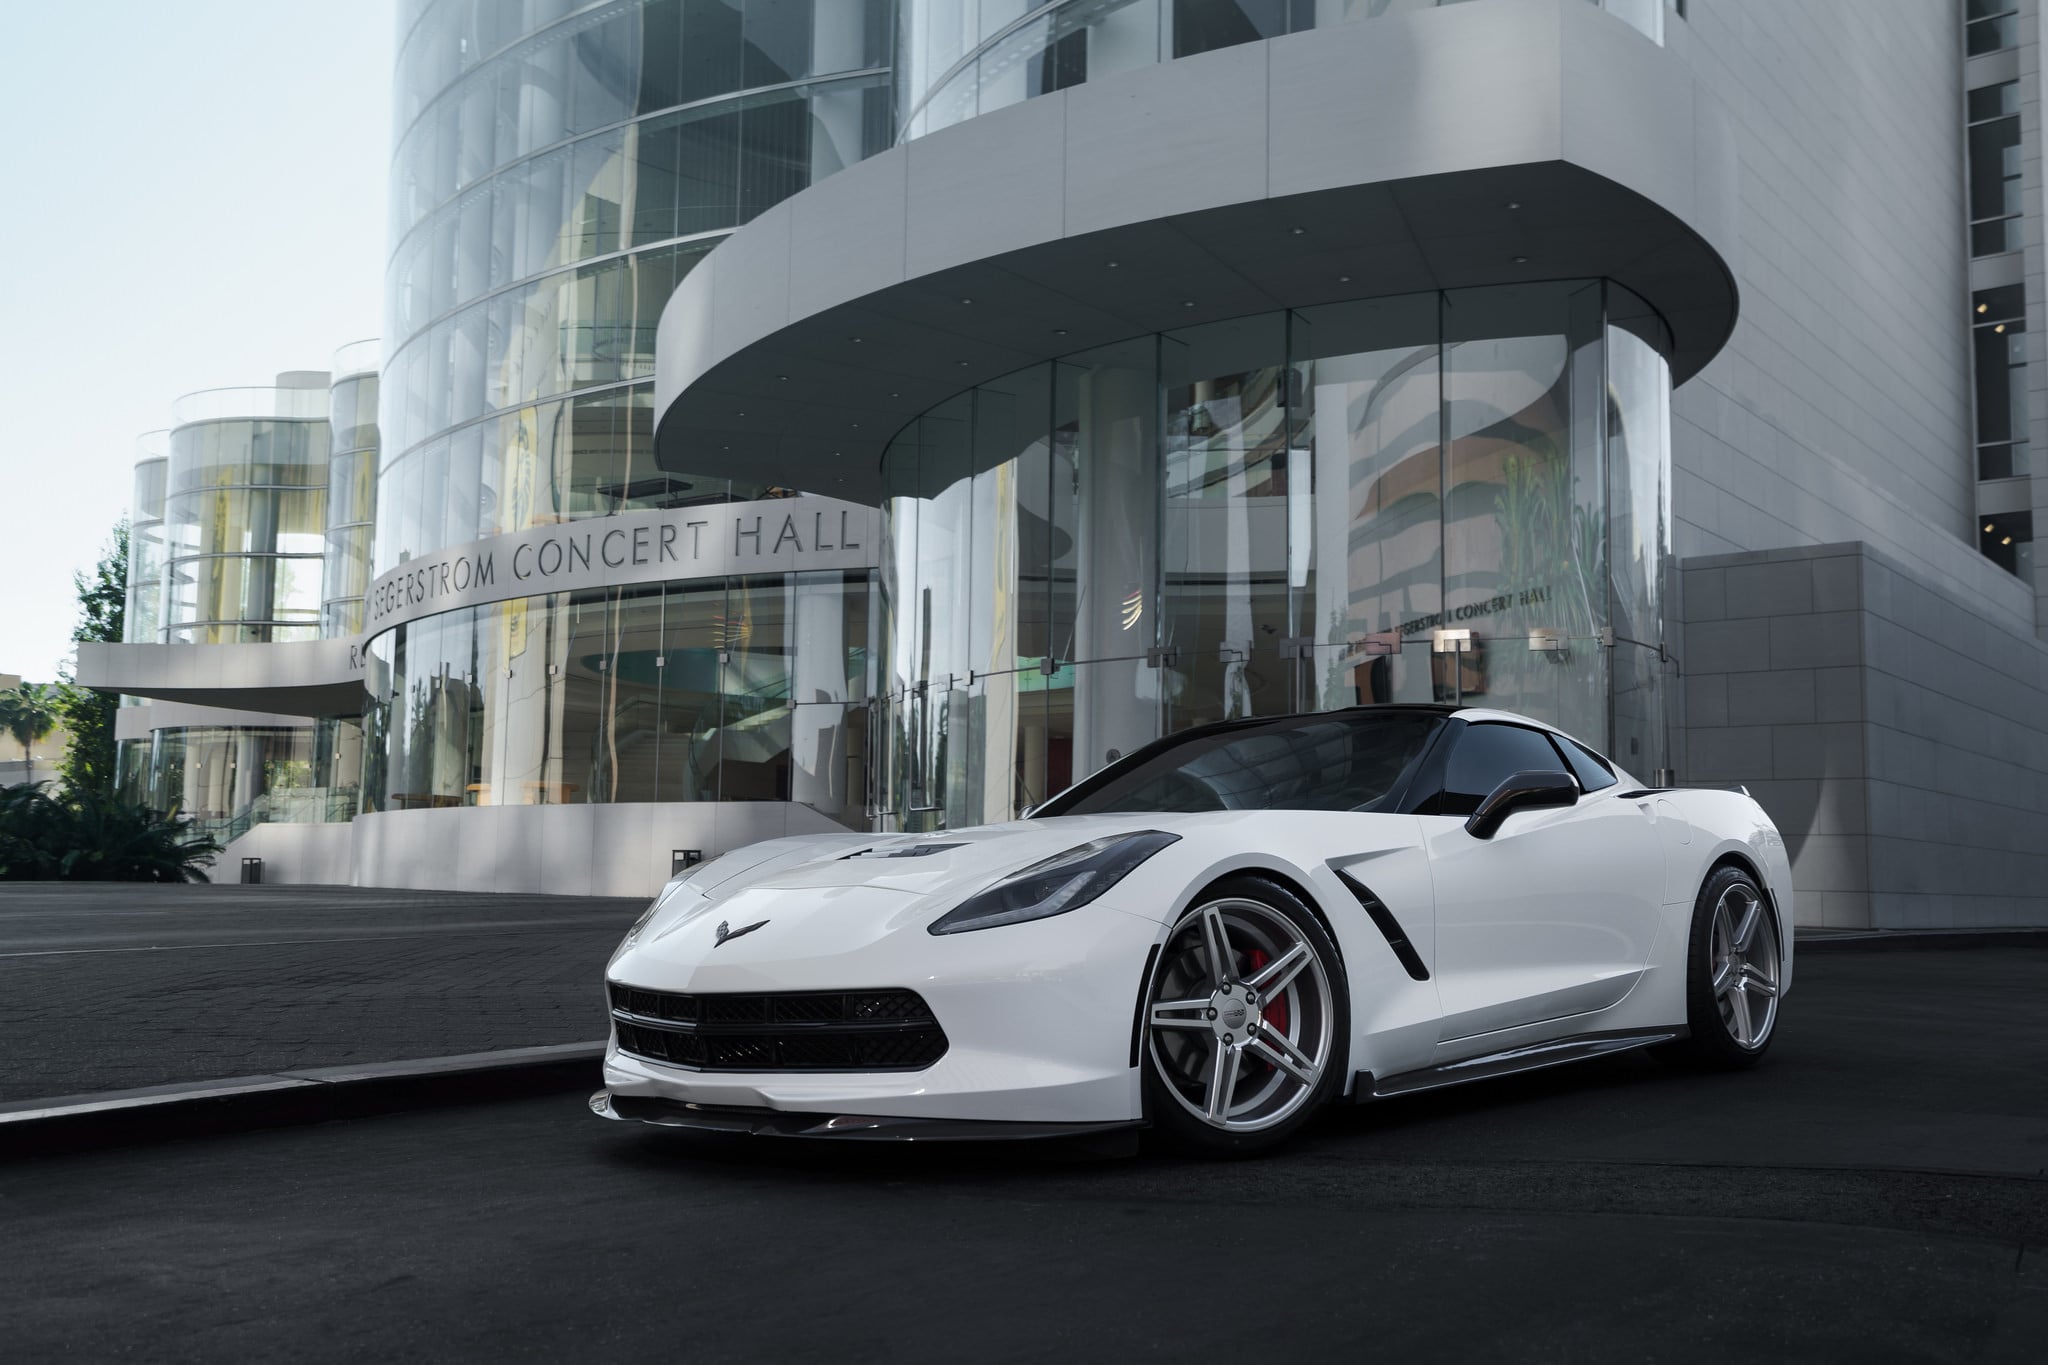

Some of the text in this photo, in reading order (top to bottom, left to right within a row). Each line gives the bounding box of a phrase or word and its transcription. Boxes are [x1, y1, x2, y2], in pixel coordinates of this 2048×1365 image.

[374, 510, 860, 620] SEGERSTROM CONCERT HALL
[1456, 593, 1513, 621] CONCERT
